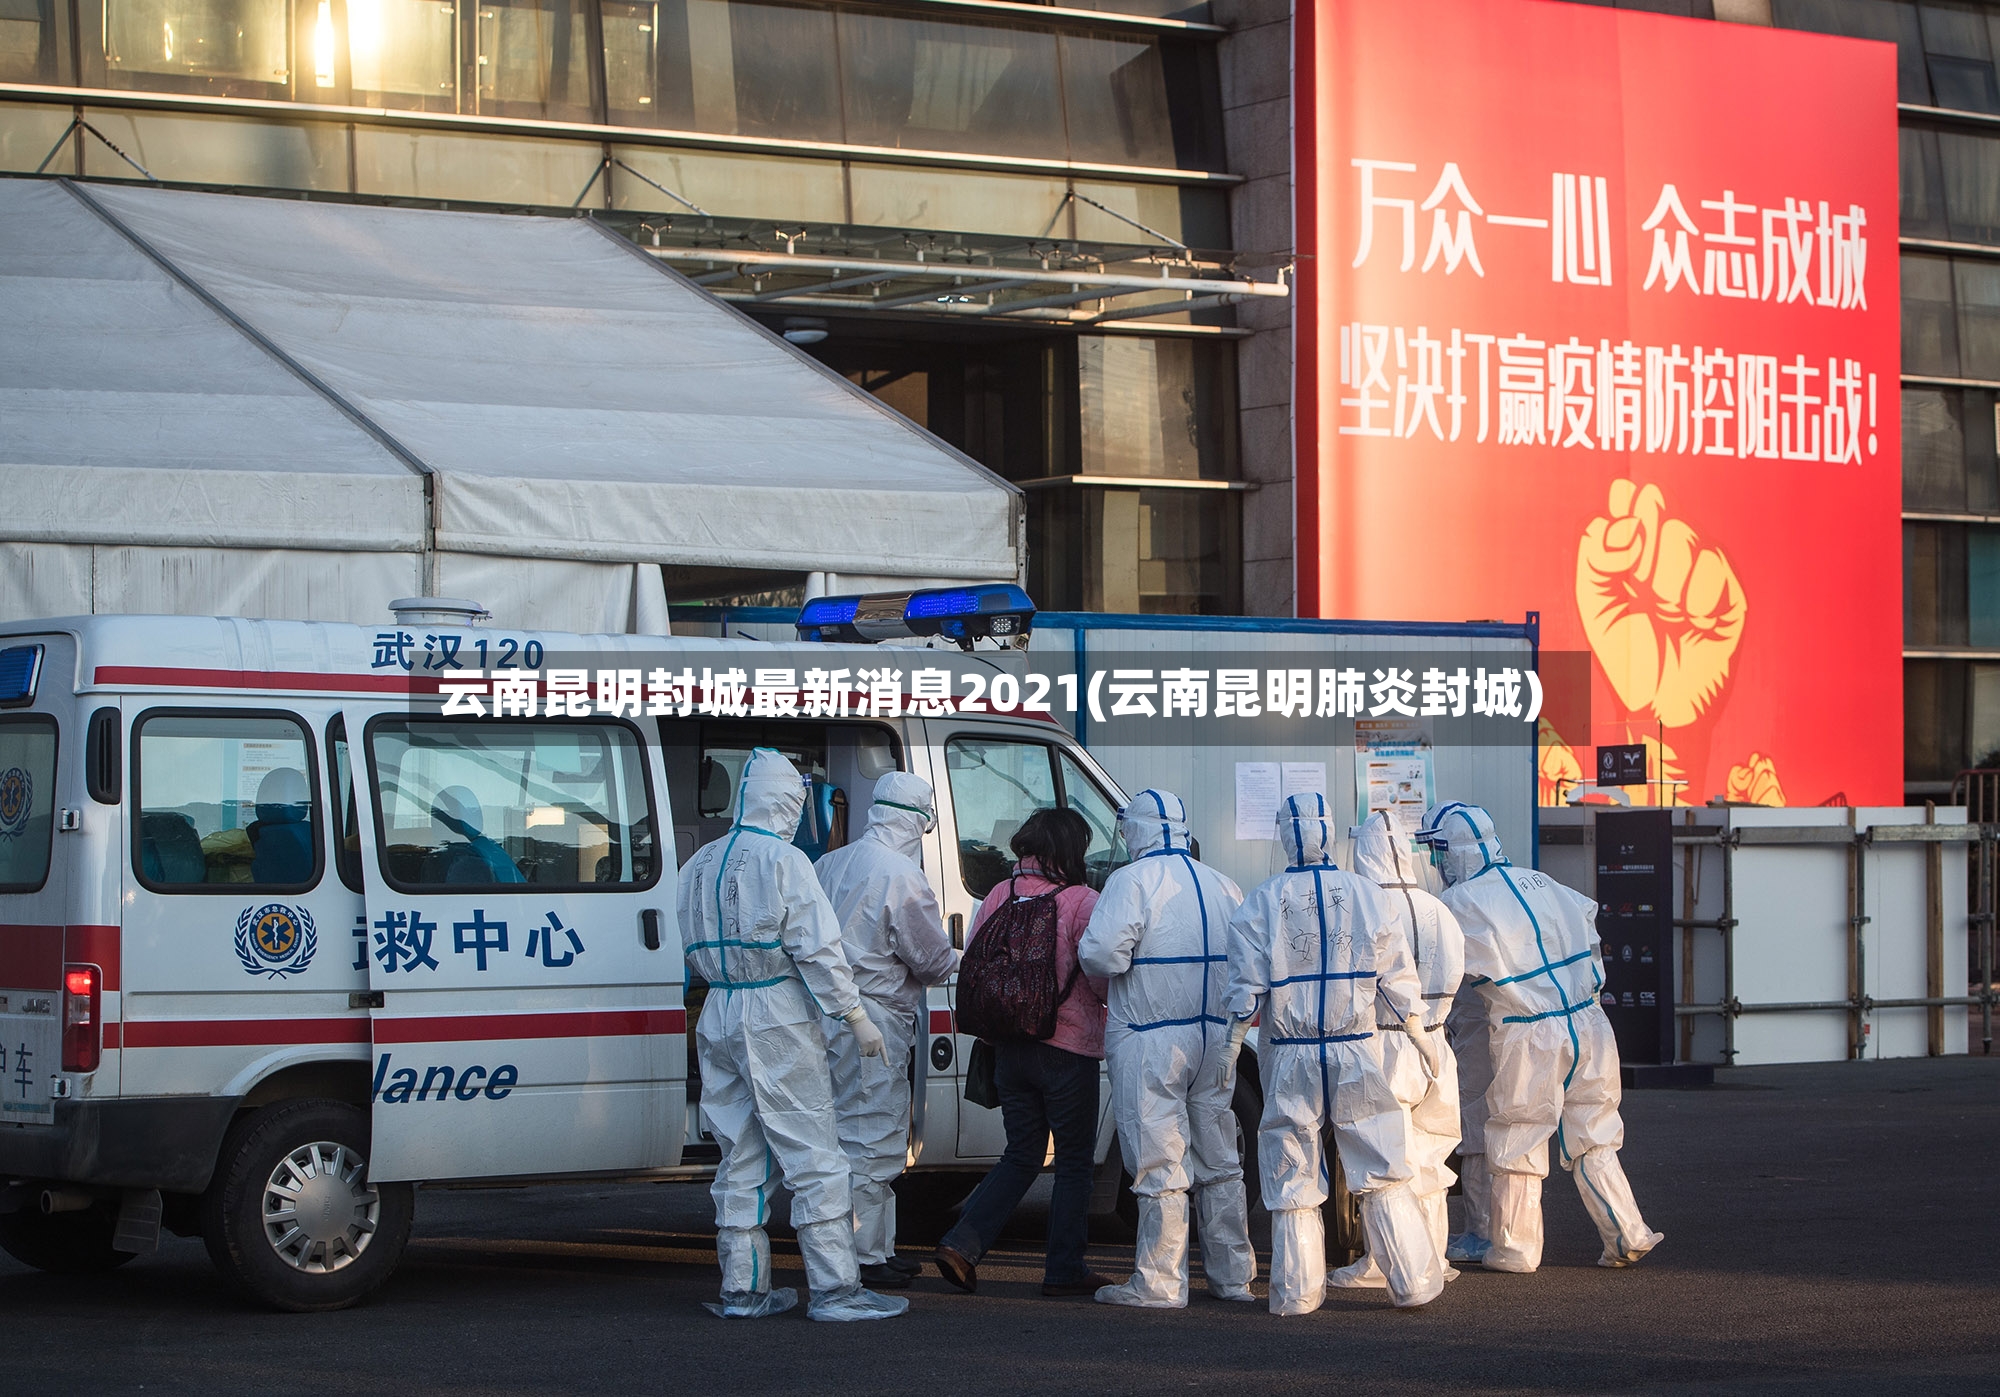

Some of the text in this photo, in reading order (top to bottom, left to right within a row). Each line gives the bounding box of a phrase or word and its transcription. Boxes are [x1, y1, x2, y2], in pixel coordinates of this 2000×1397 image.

[1351, 158, 1868, 311] 万众一心 众志成城
[371, 631, 544, 670] 武汉120
